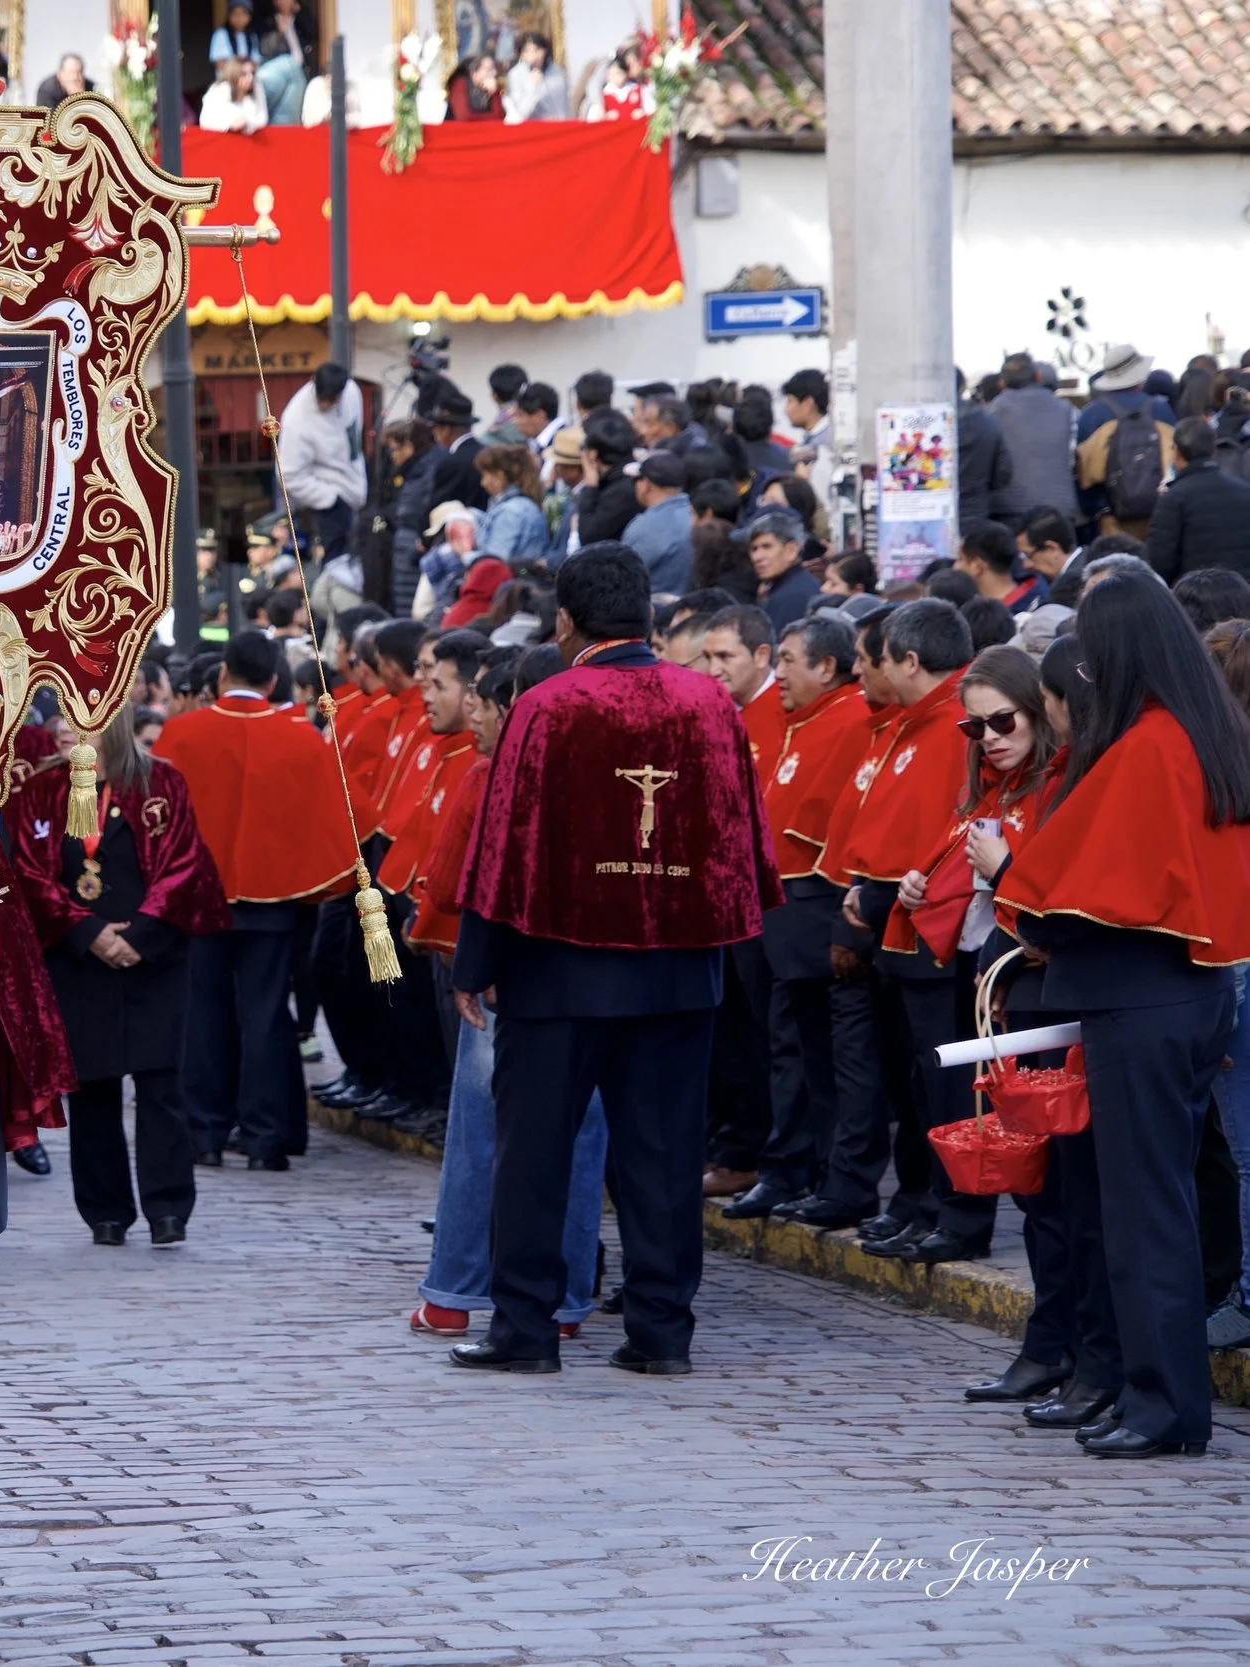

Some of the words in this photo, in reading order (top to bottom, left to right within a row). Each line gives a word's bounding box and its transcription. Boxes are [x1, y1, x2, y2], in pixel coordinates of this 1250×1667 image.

[67, 307, 87, 344] LOS
[204, 352, 312, 369] MARKET
[62, 360, 84, 450] TEMBLORES
[32, 486, 70, 571] CENTRAL
